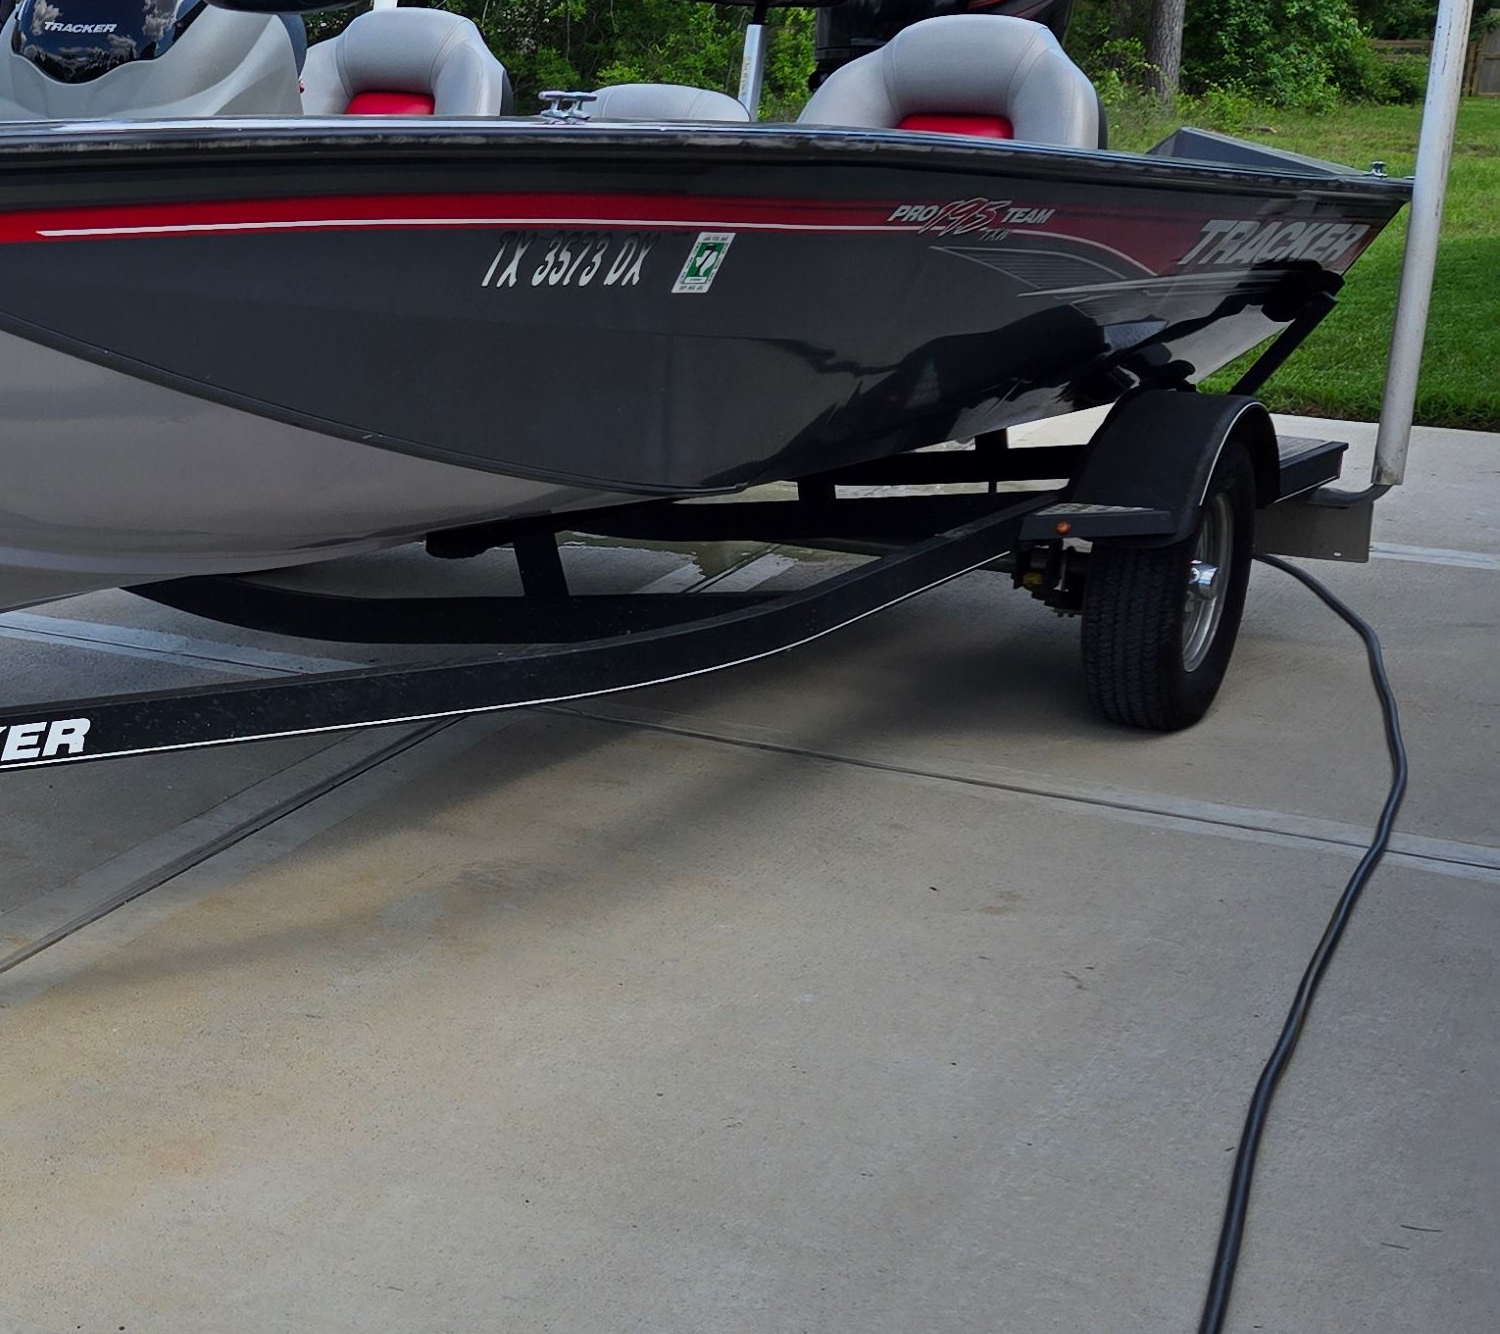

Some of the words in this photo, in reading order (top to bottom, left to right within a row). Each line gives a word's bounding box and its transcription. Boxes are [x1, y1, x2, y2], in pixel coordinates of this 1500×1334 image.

[44, 21, 117, 33] TRACKER
[887, 205, 939, 222] PRO
[1001, 207, 1056, 224] TEAM
[1177, 219, 1370, 265] TRACKER
[481, 230, 538, 288] TX
